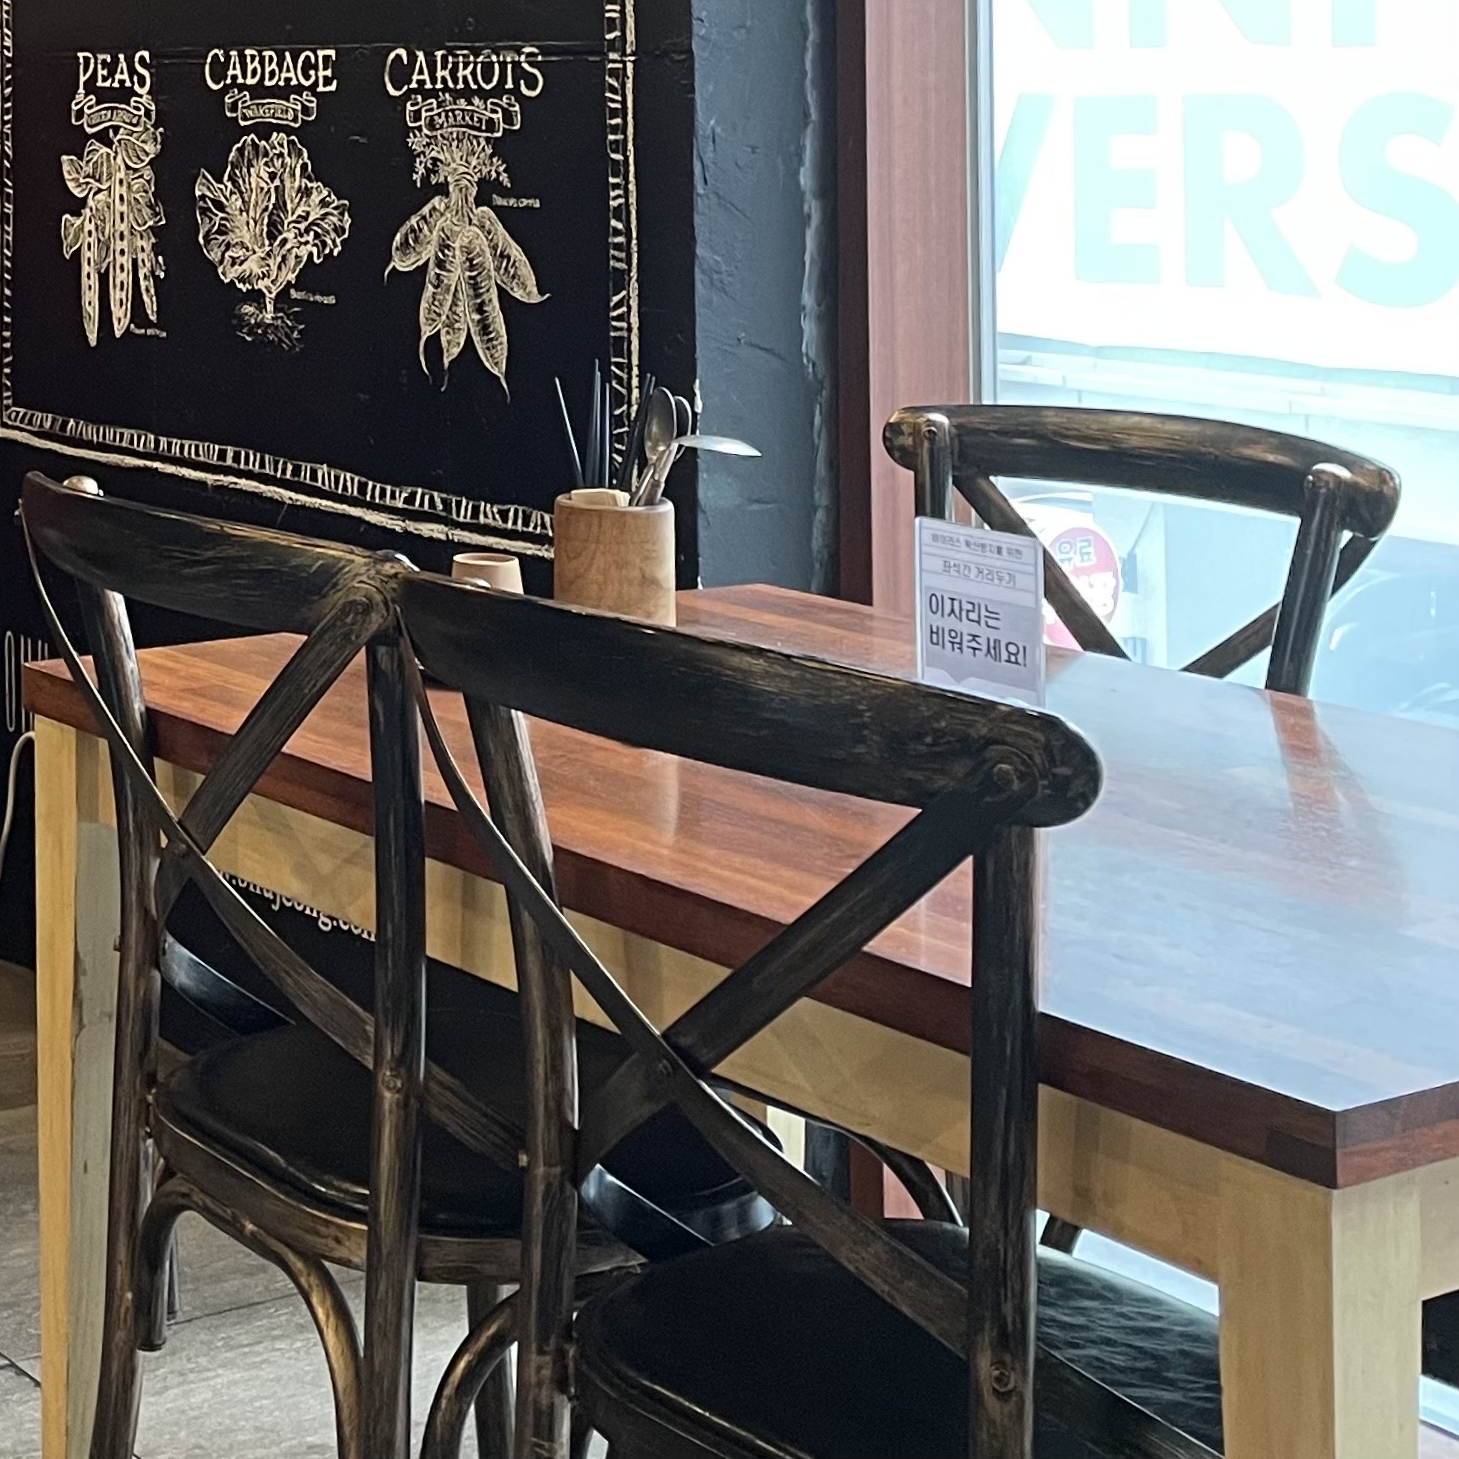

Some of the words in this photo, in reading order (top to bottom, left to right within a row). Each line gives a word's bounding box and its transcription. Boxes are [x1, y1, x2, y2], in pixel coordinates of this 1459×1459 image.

[76, 49, 152, 95] PEAS
[204, 48, 338, 93] CABBAGE
[384, 46, 545, 98] CARROTS
[974, 565, 1017, 587] 거리두기
[929, 592, 1001, 631] 이자리는
[929, 623, 1027, 668] 비워주세요!
